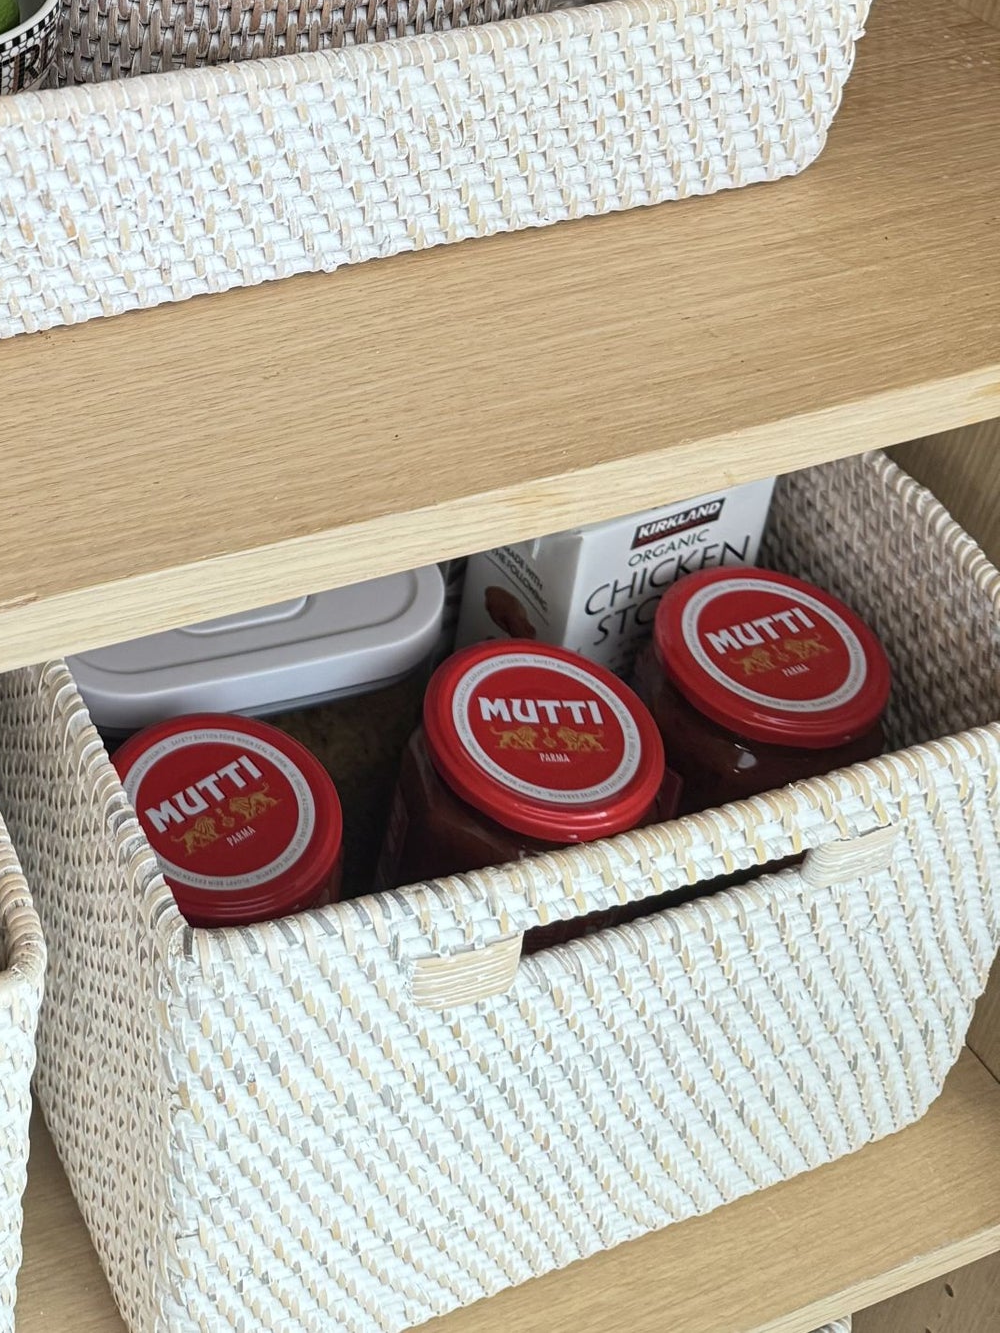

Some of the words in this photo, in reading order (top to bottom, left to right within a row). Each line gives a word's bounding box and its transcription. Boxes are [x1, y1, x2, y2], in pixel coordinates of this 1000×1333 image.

[637, 501, 722, 539] KIRKLAND
[628, 529, 709, 567] ORGANIC
[584, 535, 750, 616] CHICKEN
[704, 607, 816, 655] MUTTI
[782, 664, 810, 677] PARMA
[478, 696, 604, 725] MUTTI
[539, 752, 571, 763] PARMA
[144, 755, 263, 834] MUTTI
[226, 825, 256, 847] PARMA
